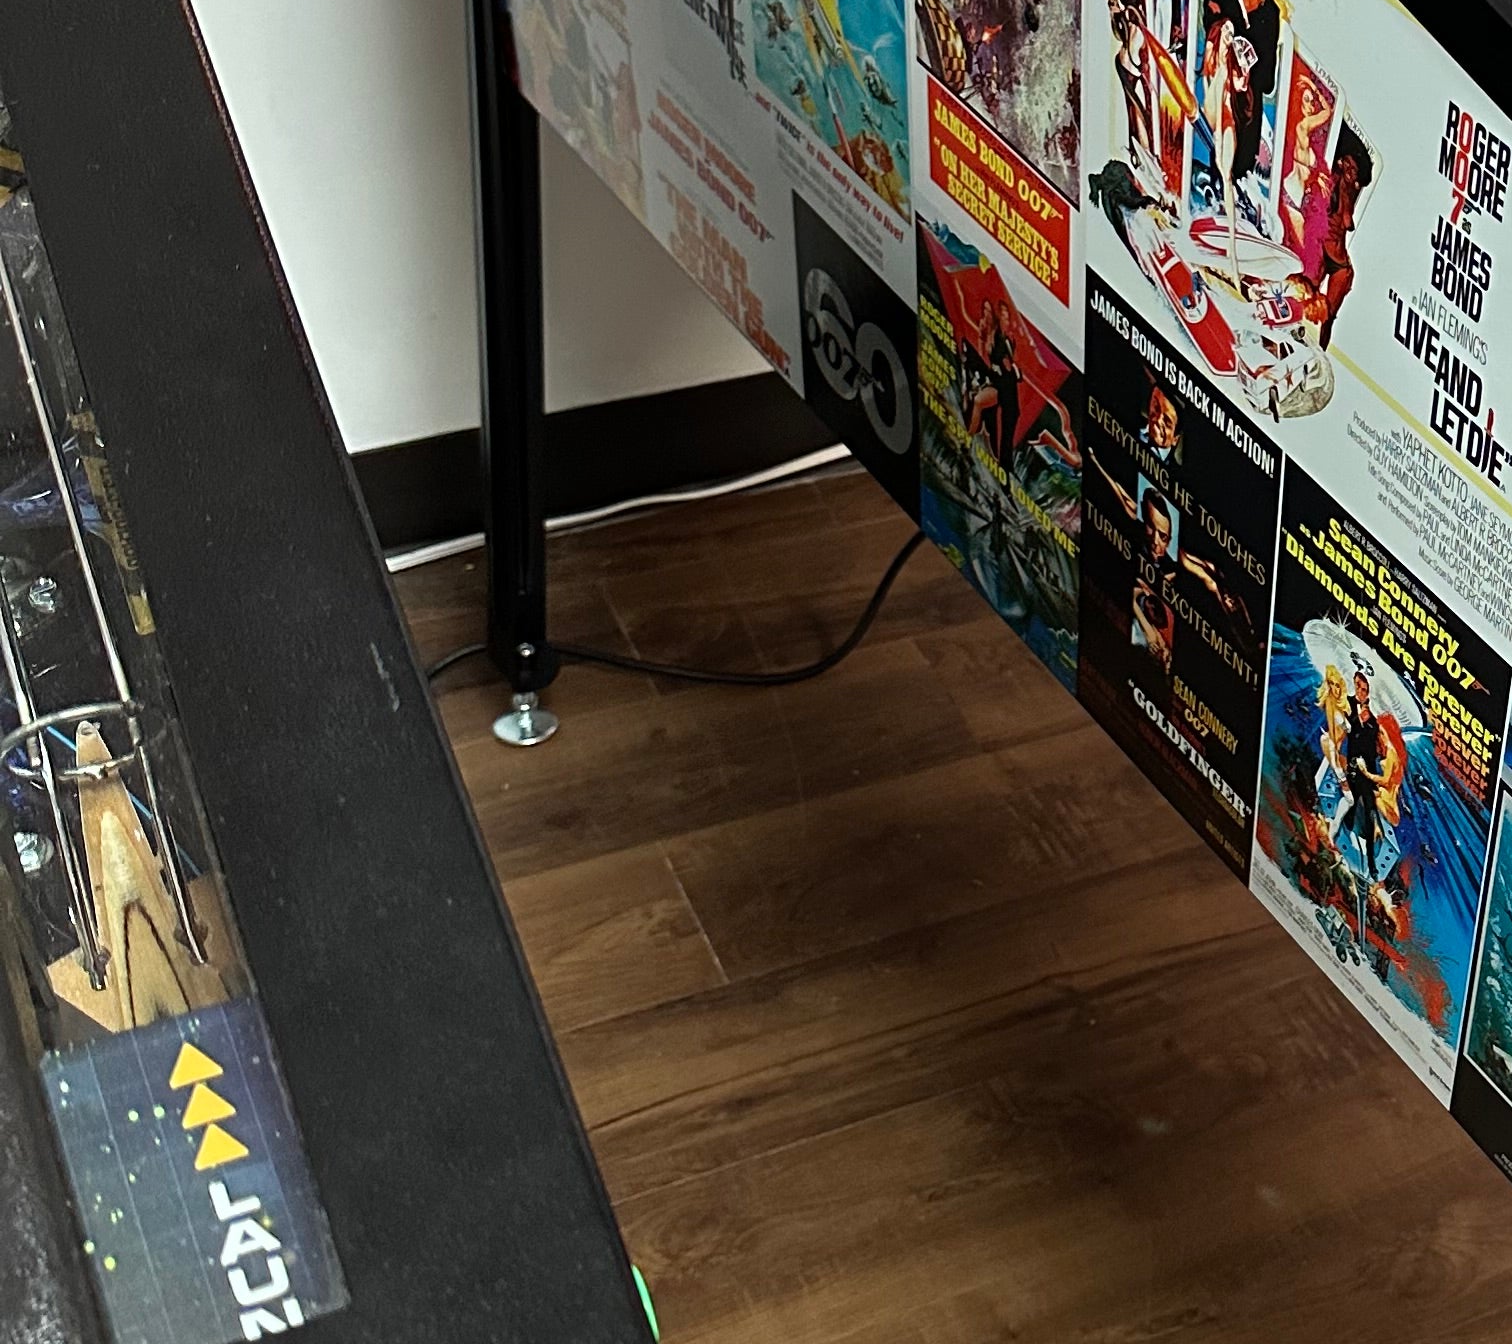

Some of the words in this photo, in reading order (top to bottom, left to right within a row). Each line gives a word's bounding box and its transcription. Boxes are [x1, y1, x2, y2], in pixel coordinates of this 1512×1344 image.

[934, 99, 976, 154] JAMES
[980, 141, 1014, 188] BOND
[1018, 179, 1054, 221] 007
[1439, 136, 1506, 223] MOORE
[1446, 100, 1511, 185] ROGER
[949, 173, 995, 232] SECRET
[961, 161, 986, 202] HER
[989, 187, 1059, 270] MAJESTY'S
[1431, 214, 1492, 291] JAMES
[1431, 251, 1483, 323] BOND
[1419, 288, 1436, 321] IAN
[1090, 290, 1129, 340] JAMES
[1131, 325, 1163, 372] BOND
[1165, 357, 1176, 385] IS
[1179, 371, 1210, 418] BACK
[1212, 403, 1225, 432] IN
[1226, 422, 1275, 478] ACTION!
[1431, 388, 1469, 453] LET
[1434, 345, 1482, 418] AND
[1089, 395, 1169, 491] EVERYTHING
[1174, 481, 1194, 516] HE
[1199, 505, 1266, 586] TOUCHES
[1085, 498, 1131, 561] TURNS
[1138, 553, 1155, 585] TO
[1162, 577, 1258, 692] EXCITEMENT!
[1313, 530, 1376, 600] James
[1379, 592, 1429, 652] Bond
[1432, 643, 1478, 691] 007
[1329, 517, 1375, 576] Sean
[1378, 564, 1459, 656] Connery
[1382, 628, 1415, 672] Are
[1174, 675, 1196, 711] SEAN
[1198, 701, 1239, 755] CONNERY
